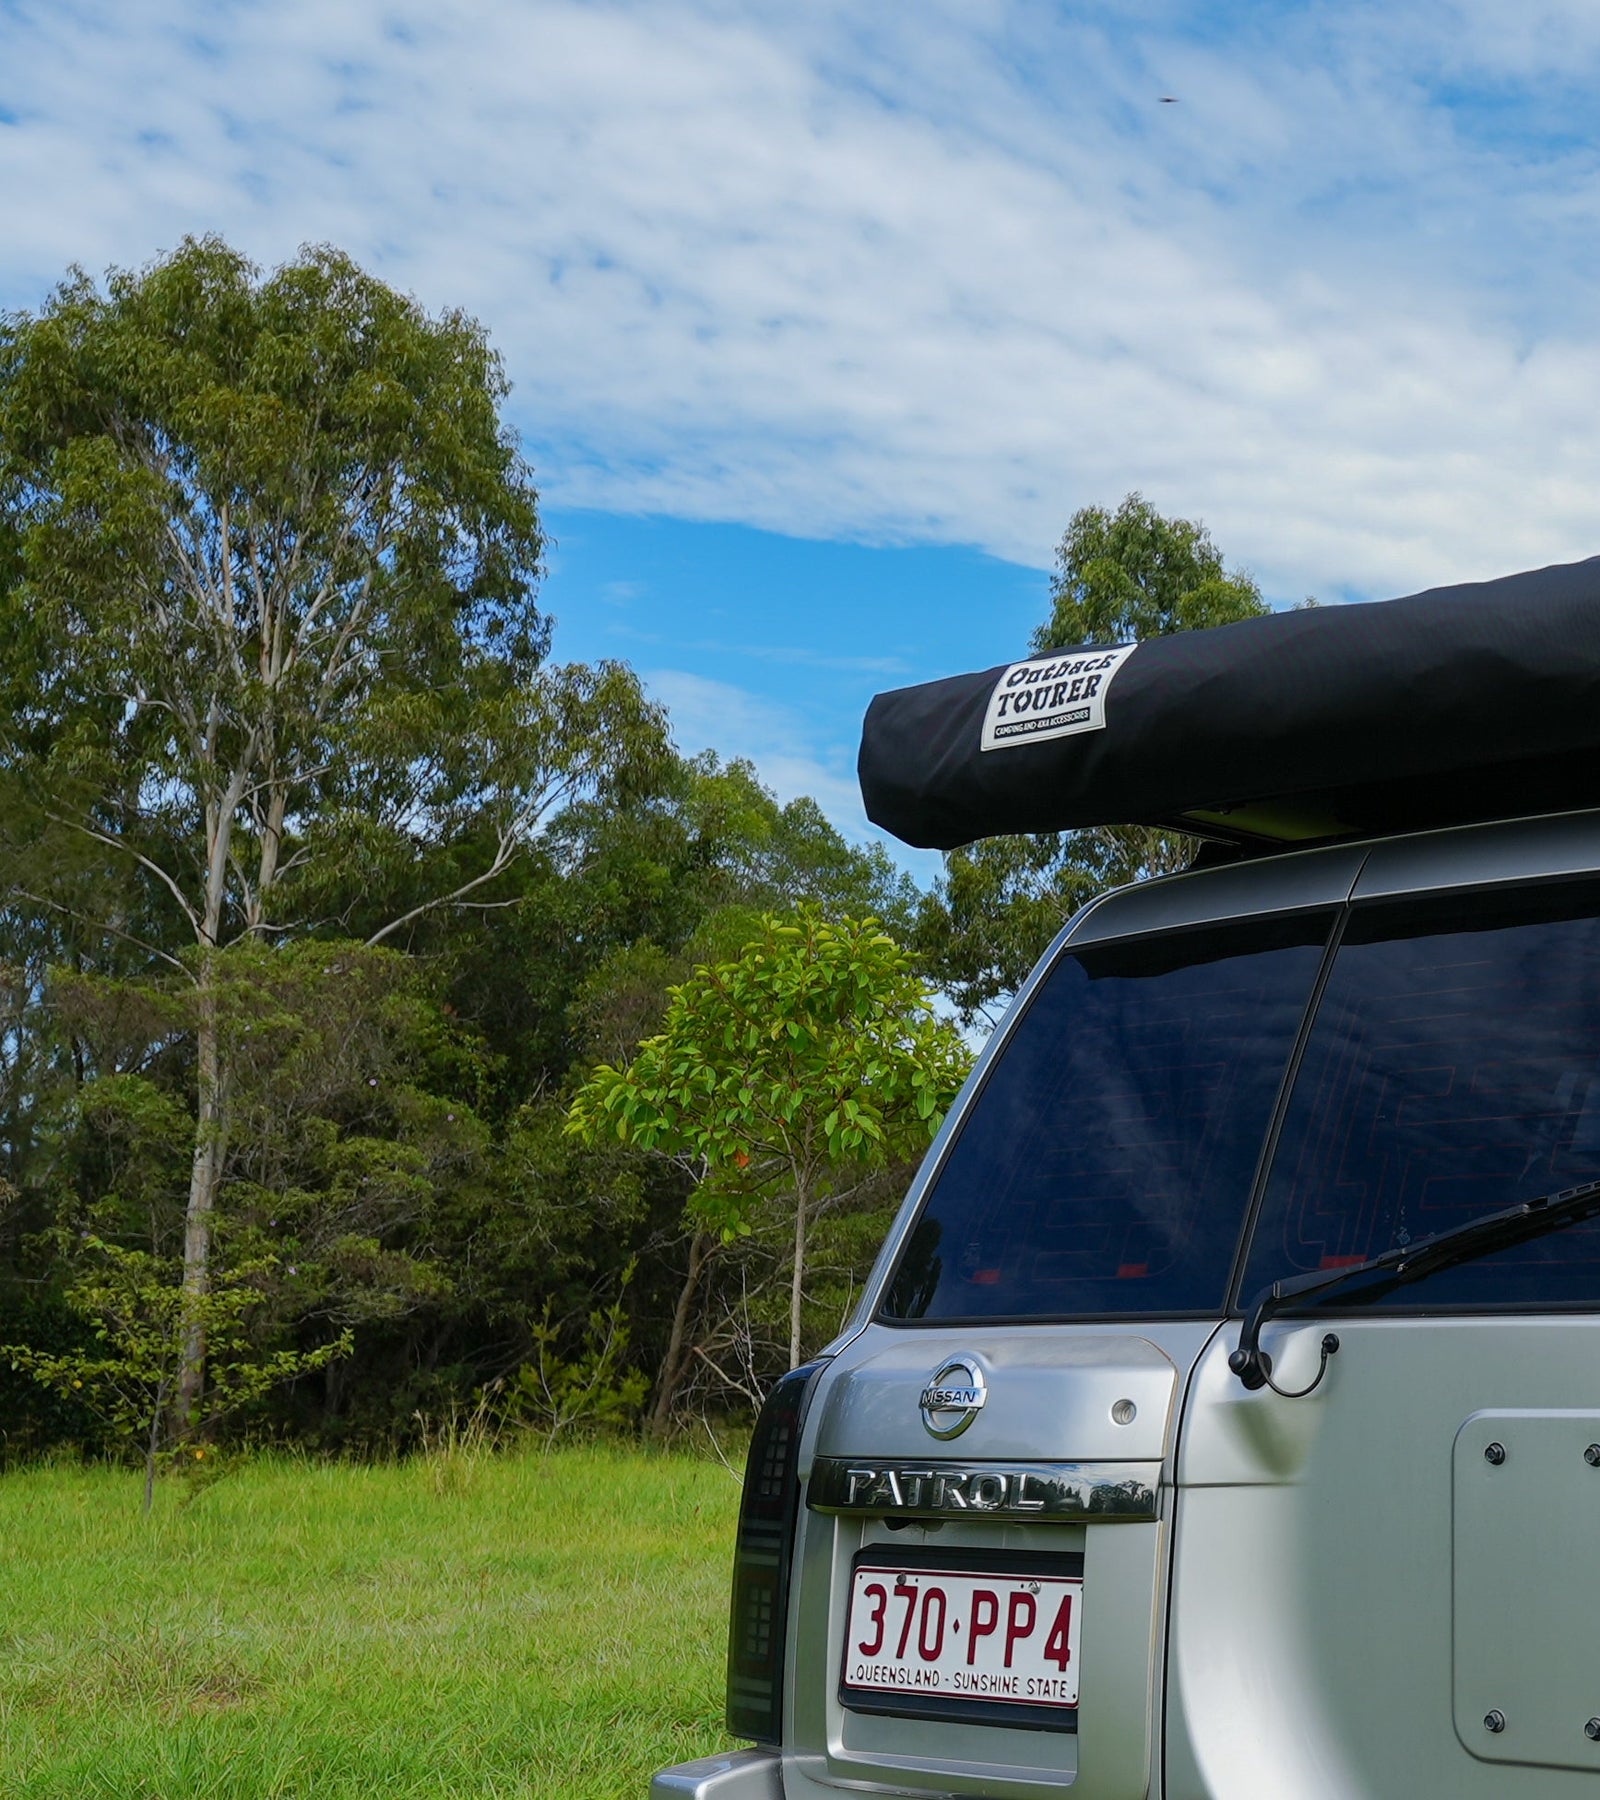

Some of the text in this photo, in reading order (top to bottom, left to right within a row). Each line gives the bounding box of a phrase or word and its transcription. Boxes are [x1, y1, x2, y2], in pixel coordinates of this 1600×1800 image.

[1006, 654, 1119, 687] Outback
[997, 674, 1102, 716] TOURER
[995, 724, 1023, 735] CAMPING
[1024, 721, 1036, 730] AND
[920, 1389, 976, 1404] NISSAN
[844, 1469, 1044, 1511] PATROL
[856, 1664, 940, 1687] QUEENSLAND
[953, 1672, 1019, 1695] SUNSHINE
[1026, 1678, 1068, 1698] STATE
